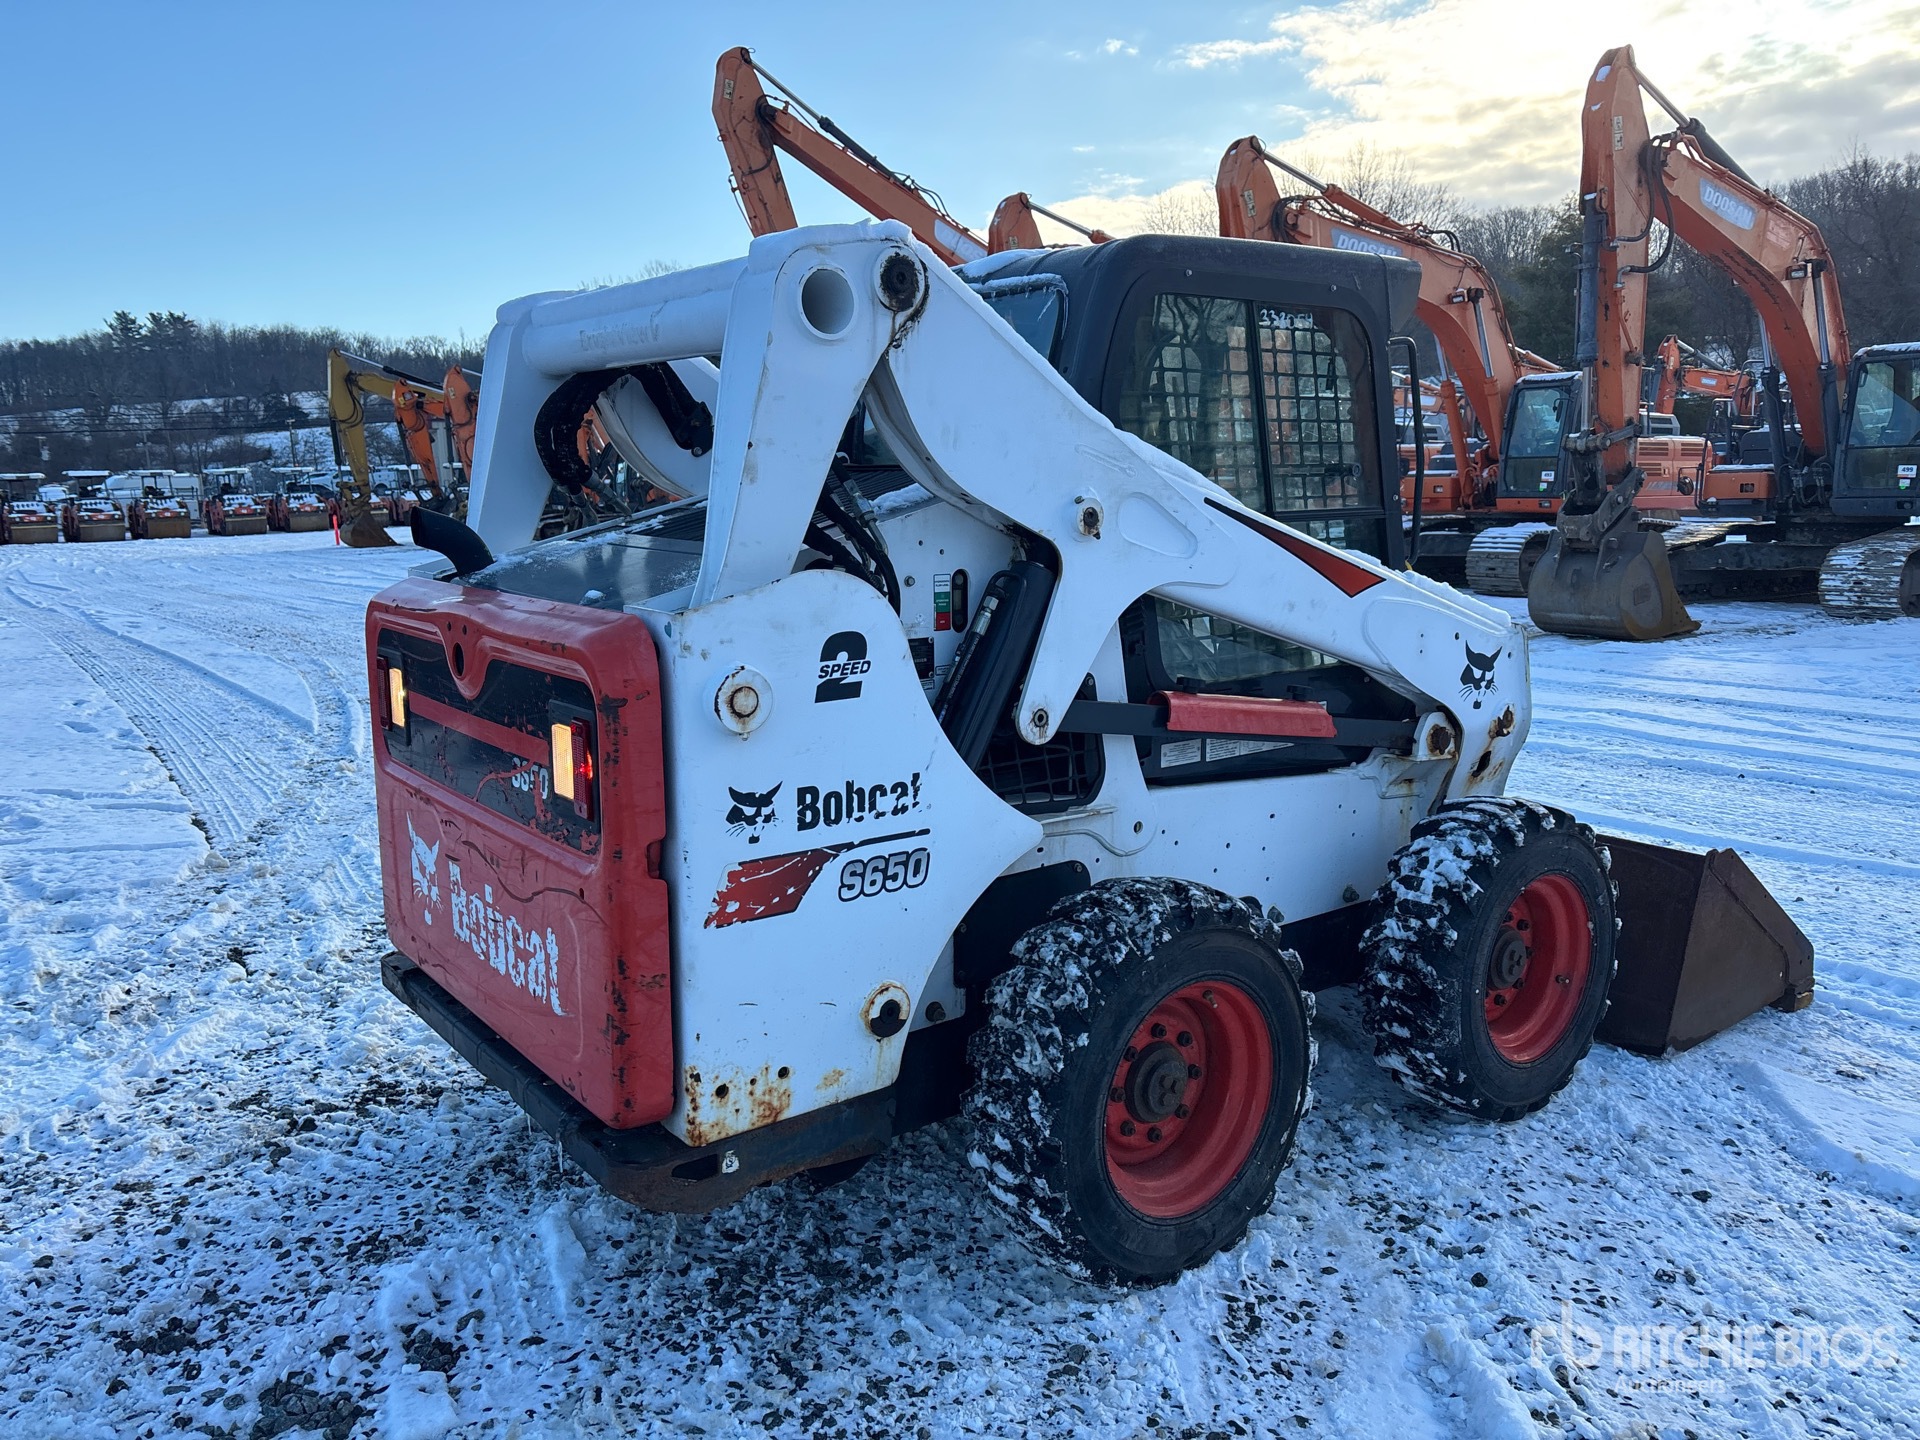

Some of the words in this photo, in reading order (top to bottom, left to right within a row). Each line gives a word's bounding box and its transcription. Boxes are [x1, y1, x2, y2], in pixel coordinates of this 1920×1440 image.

[1704, 186, 1754, 223] DOOSAN
[815, 630, 867, 703] 2
[818, 660, 871, 679] SPEED
[797, 772, 922, 832] Bobcat
[838, 847, 931, 902] S650
